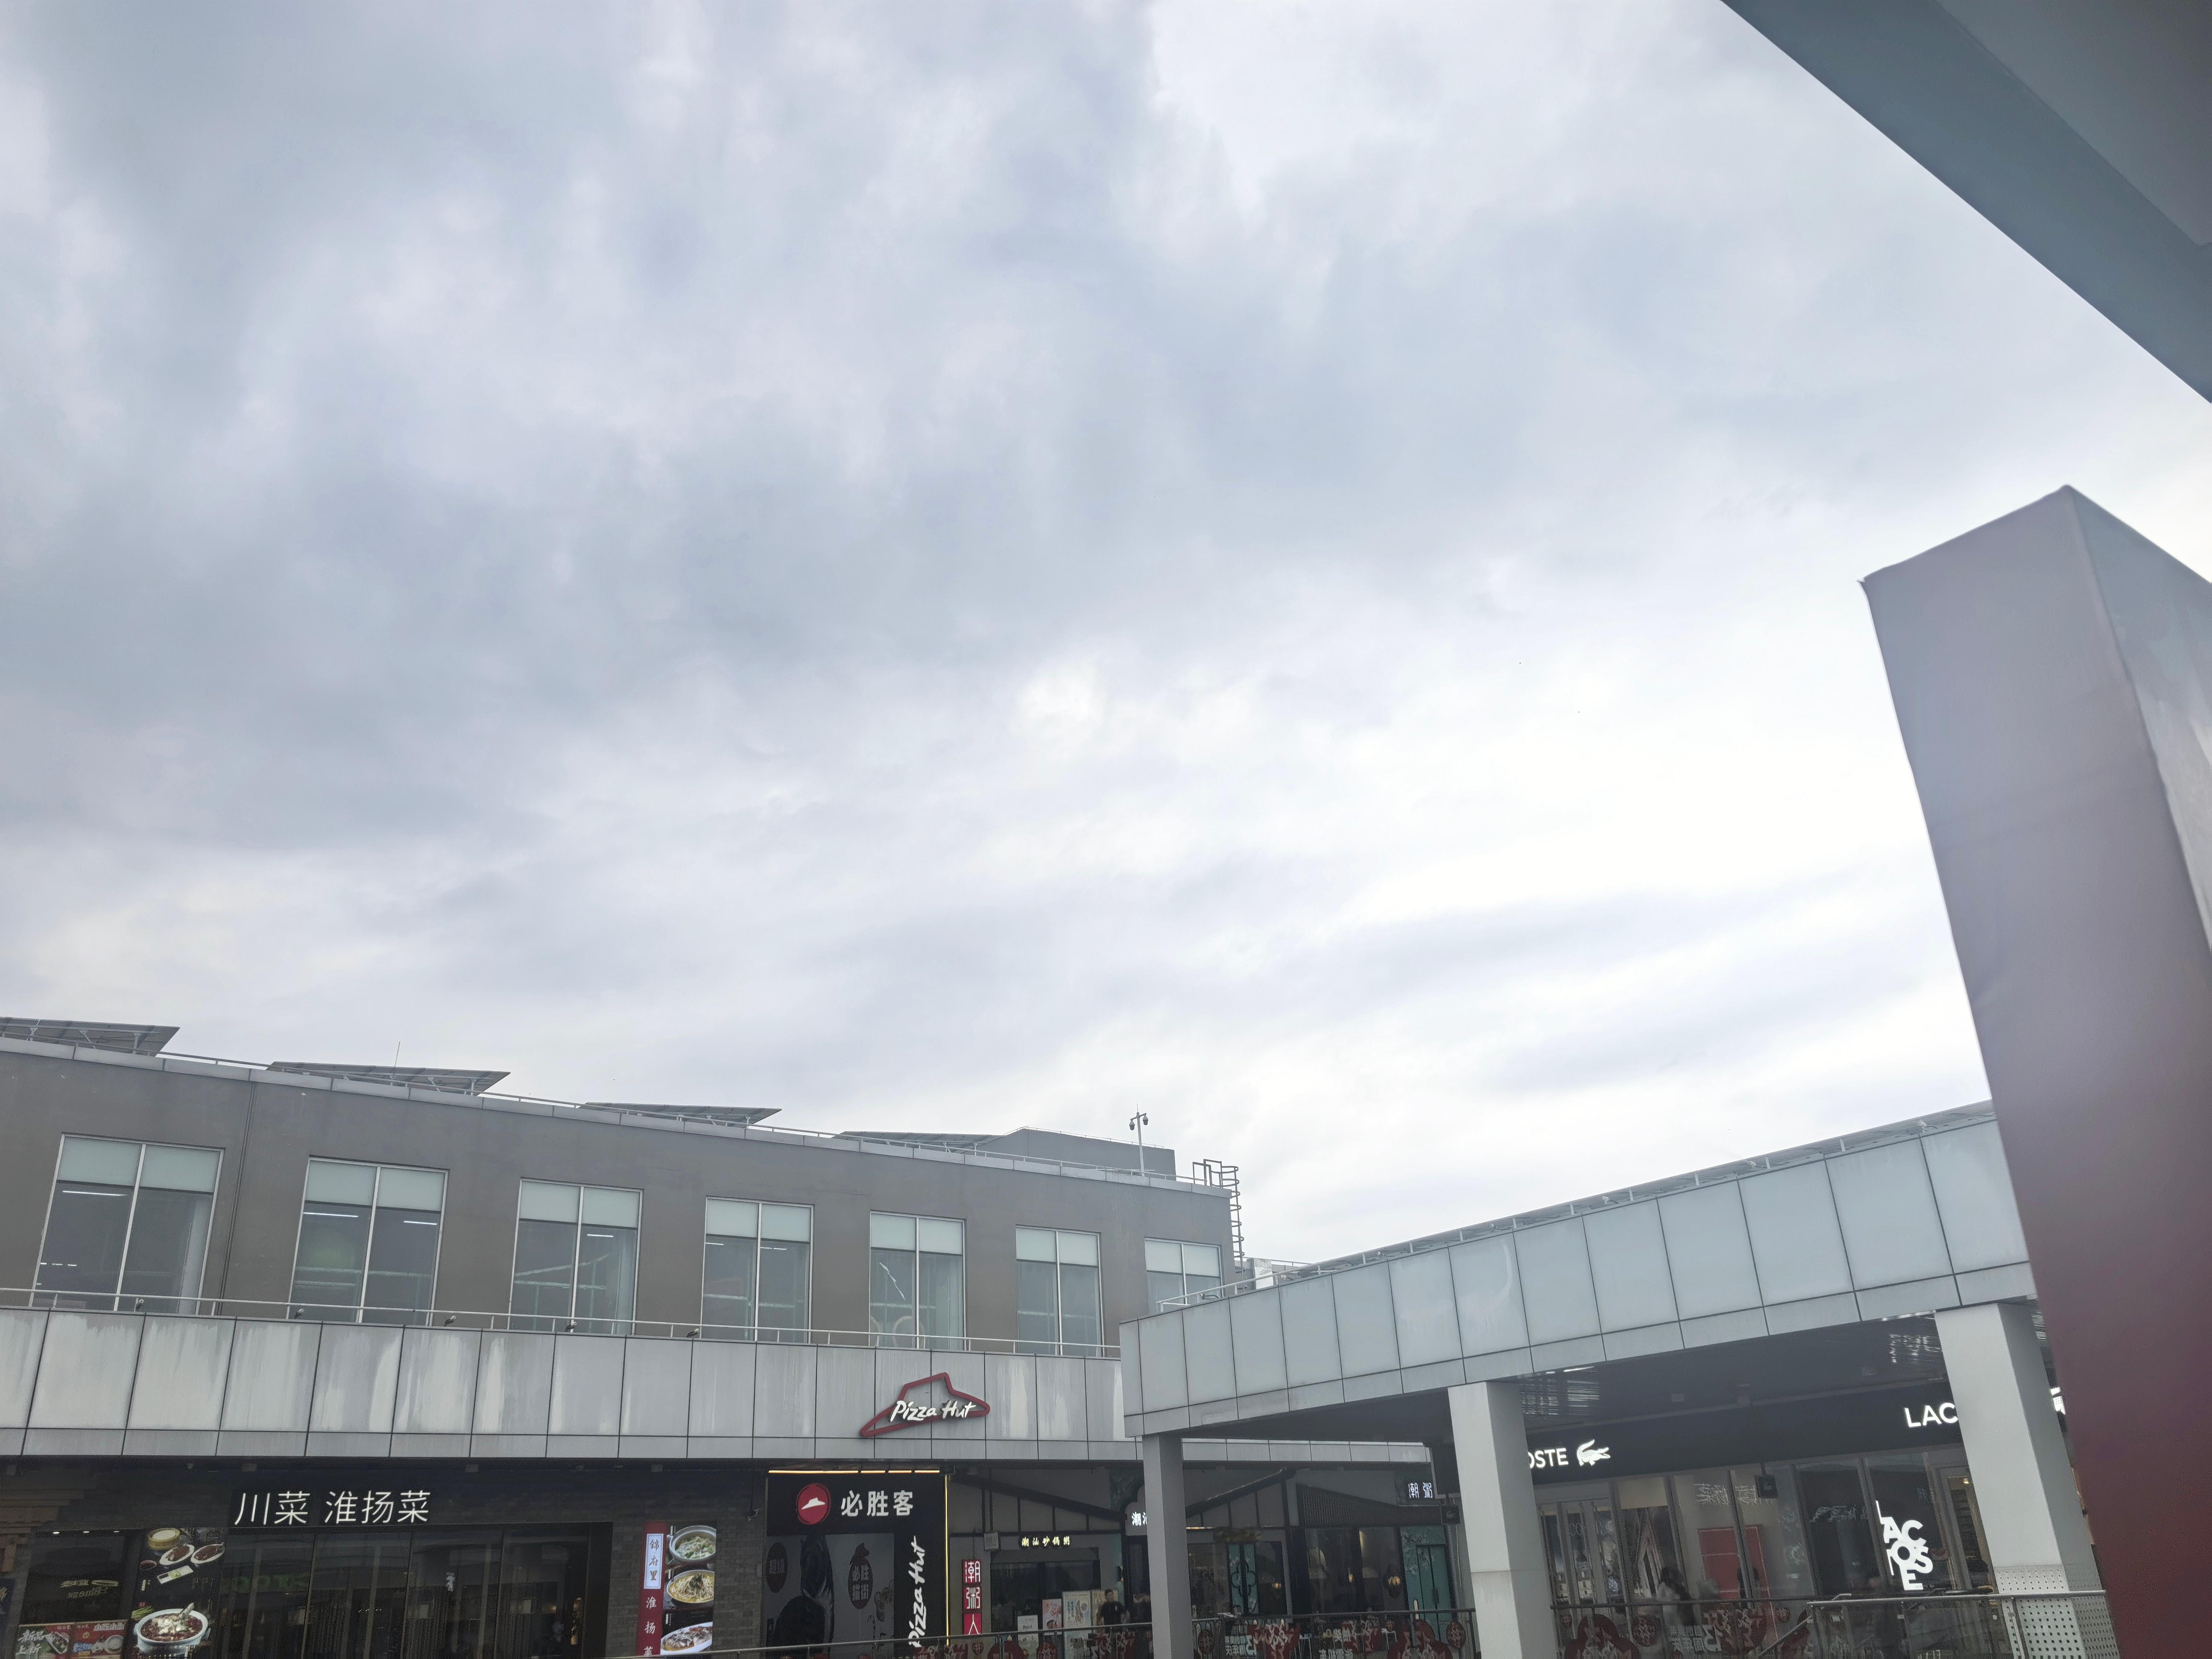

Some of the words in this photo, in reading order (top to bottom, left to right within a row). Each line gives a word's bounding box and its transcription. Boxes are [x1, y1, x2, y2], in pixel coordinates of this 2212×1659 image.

[889, 1400, 937, 1422] Pizza
[942, 1400, 976, 1419] Hut
[1904, 1403, 1958, 1427] LAC
[234, 1491, 310, 1525] 川菜
[324, 1490, 431, 1524] 淮扬菜
[841, 1490, 913, 1517] 必胜客
[1022, 1535, 1070, 1547] 潮汕砂锅粥
[908, 1535, 926, 1584] Hut
[908, 1587, 927, 1647] Pizza
